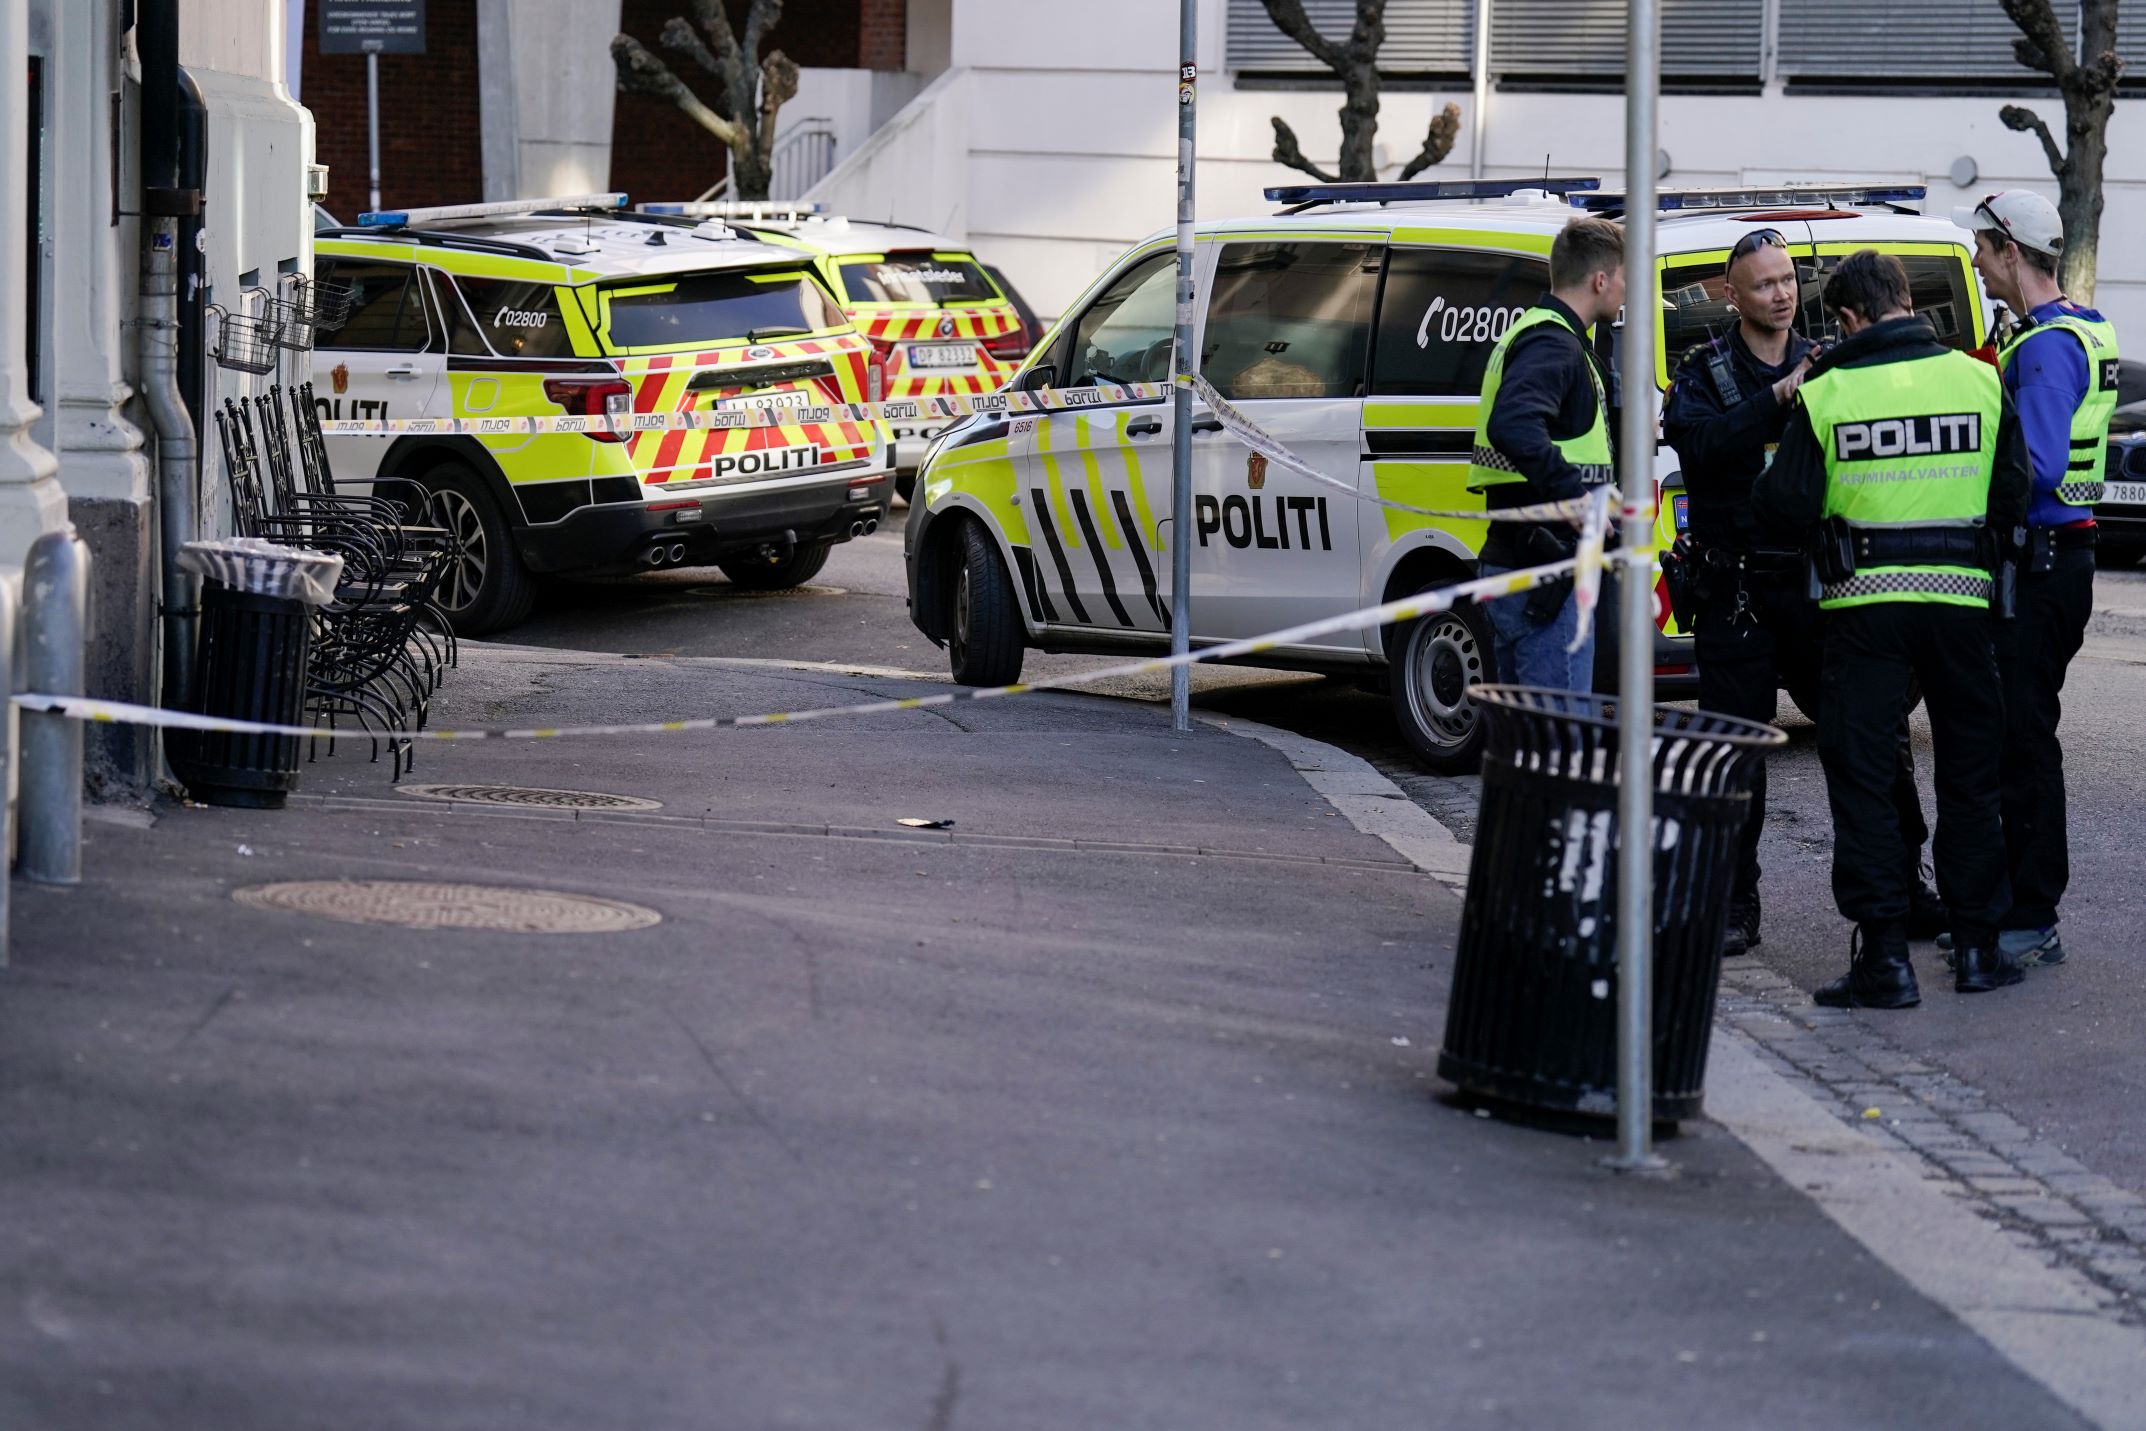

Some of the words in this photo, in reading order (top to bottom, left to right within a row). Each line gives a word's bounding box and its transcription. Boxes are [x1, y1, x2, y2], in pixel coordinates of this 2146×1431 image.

[505, 310, 547, 328] 02800
[1014, 420, 1033, 433] 6516
[1837, 415, 1979, 459] POLITI
[715, 446, 818, 477] POLITI
[1839, 465, 1980, 485] KRIMINALVAKTEN
[1195, 494, 1332, 550] POLITI
